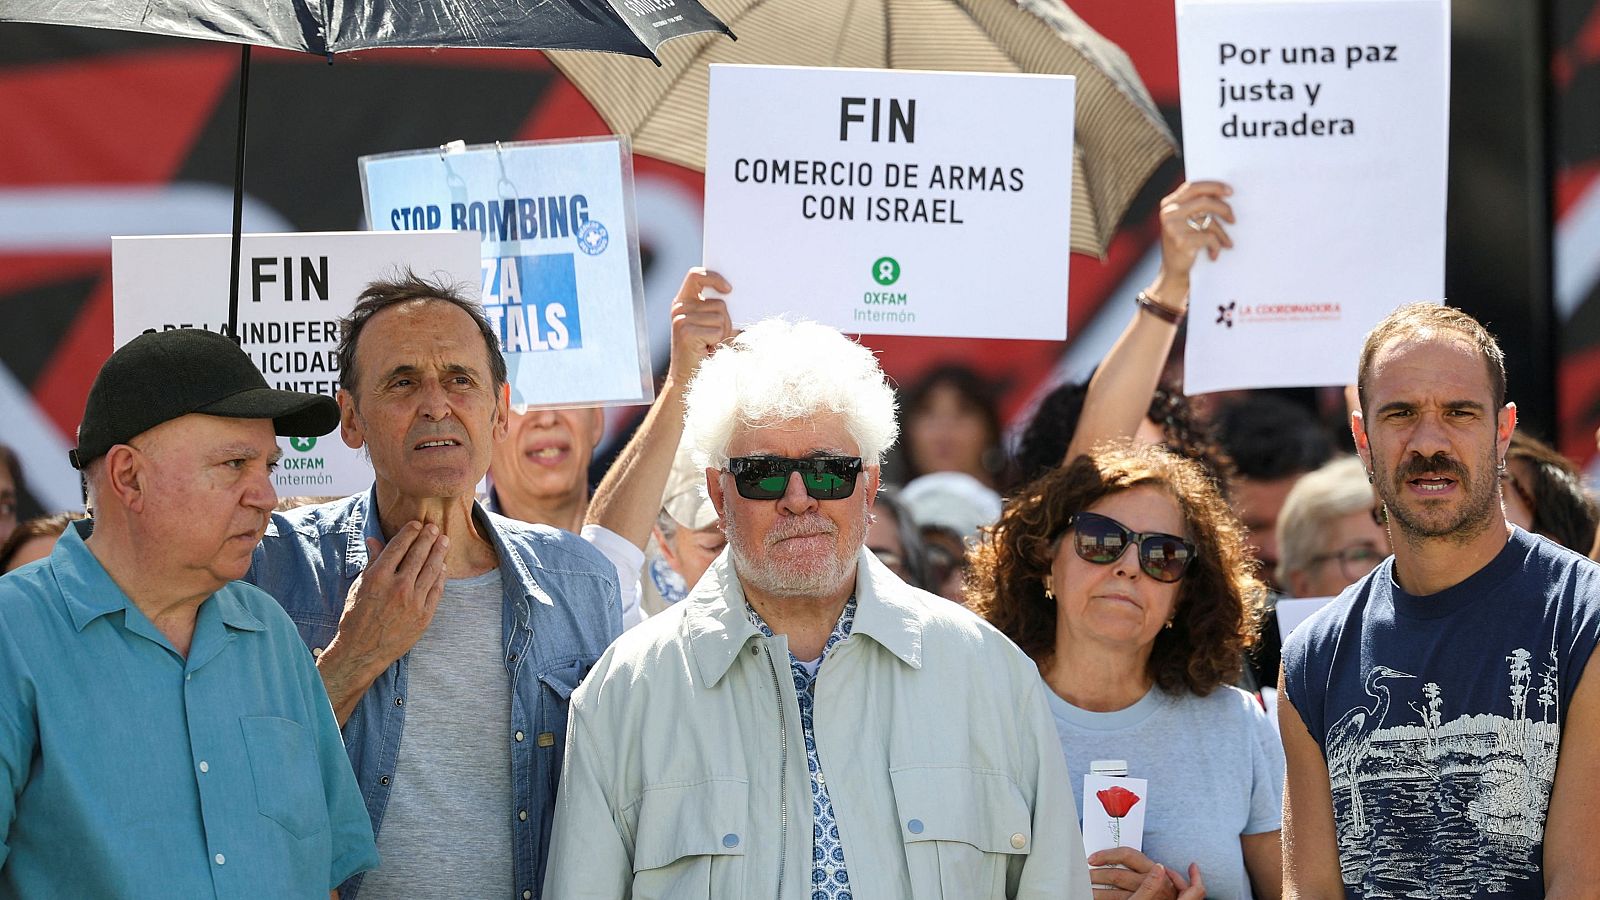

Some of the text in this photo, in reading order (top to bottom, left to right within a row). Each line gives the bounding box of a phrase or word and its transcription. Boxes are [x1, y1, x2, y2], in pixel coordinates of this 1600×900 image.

[1219, 43, 1397, 70] Por una paz
[1219, 78, 1321, 108] justa y
[840, 97, 916, 143] FIN
[1221, 113, 1354, 138] duradera
[734, 158, 1024, 192] COMERCIO DE ARMAS
[451, 194, 590, 242] BOMBING
[802, 195, 963, 224] CON ISRAEL
[251, 256, 329, 302] FIN
[863, 292, 907, 305] OXFAM
[854, 308, 915, 323] Intermón
[248, 351, 340, 373] ICIDAD
[283, 457, 324, 470] OXFAM
[275, 472, 333, 486] Intermón
